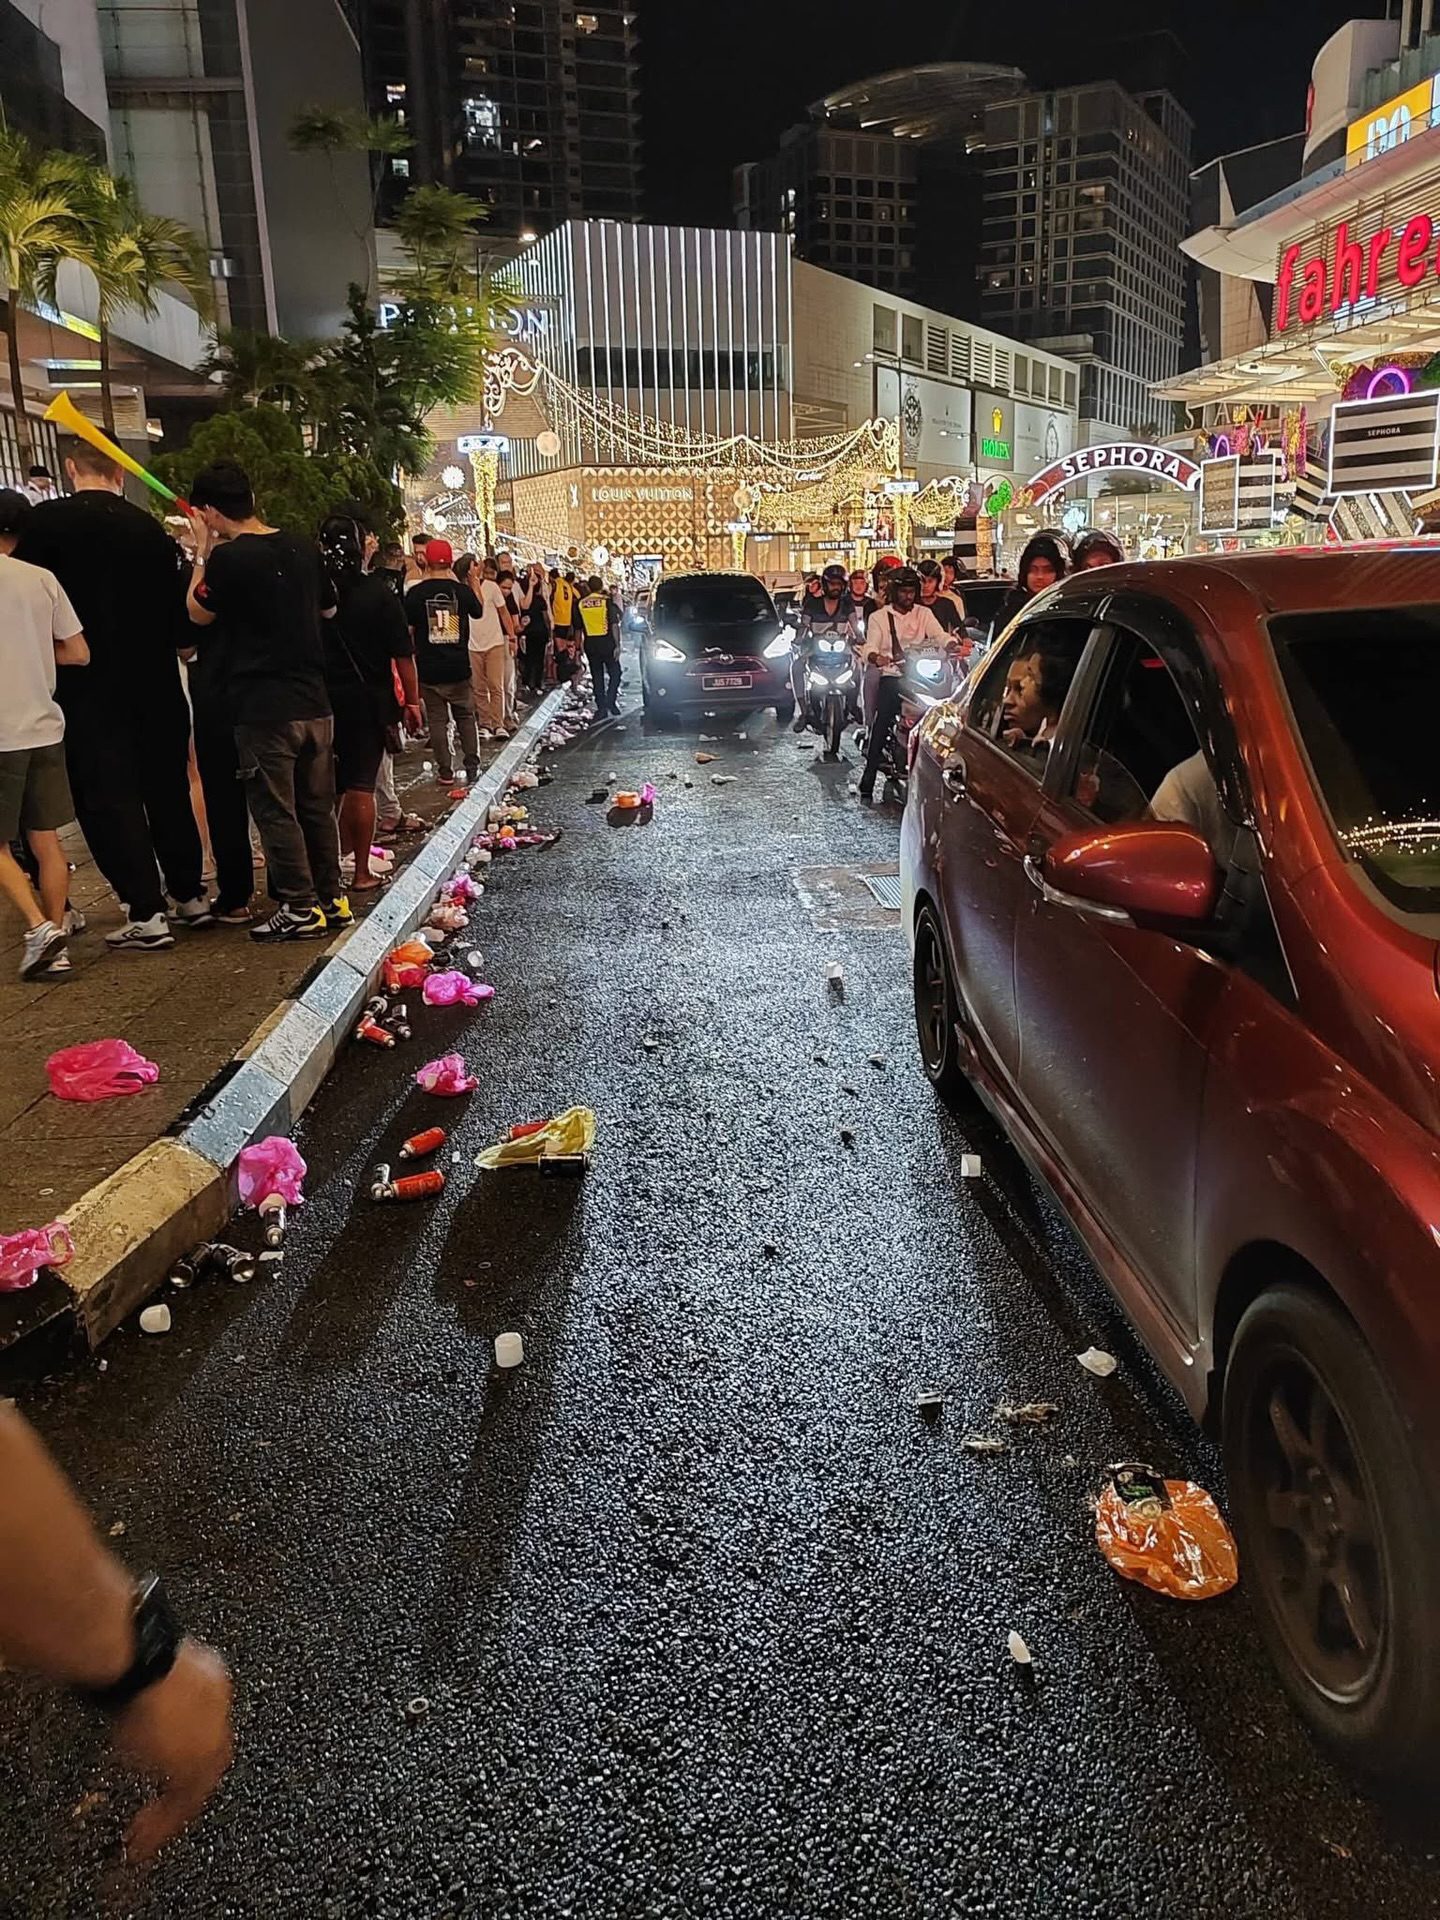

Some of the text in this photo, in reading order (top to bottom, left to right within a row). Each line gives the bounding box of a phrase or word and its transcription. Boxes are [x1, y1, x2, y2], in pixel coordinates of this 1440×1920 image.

[1277, 214, 1440, 331] fahre
[1367, 427, 1401, 437] SEPHORA
[982, 438, 1010, 460] ROLEX
[1061, 447, 1179, 478] SEPHORA
[592, 488, 632, 501] LOUIS
[636, 487, 693, 501] VUITTON
